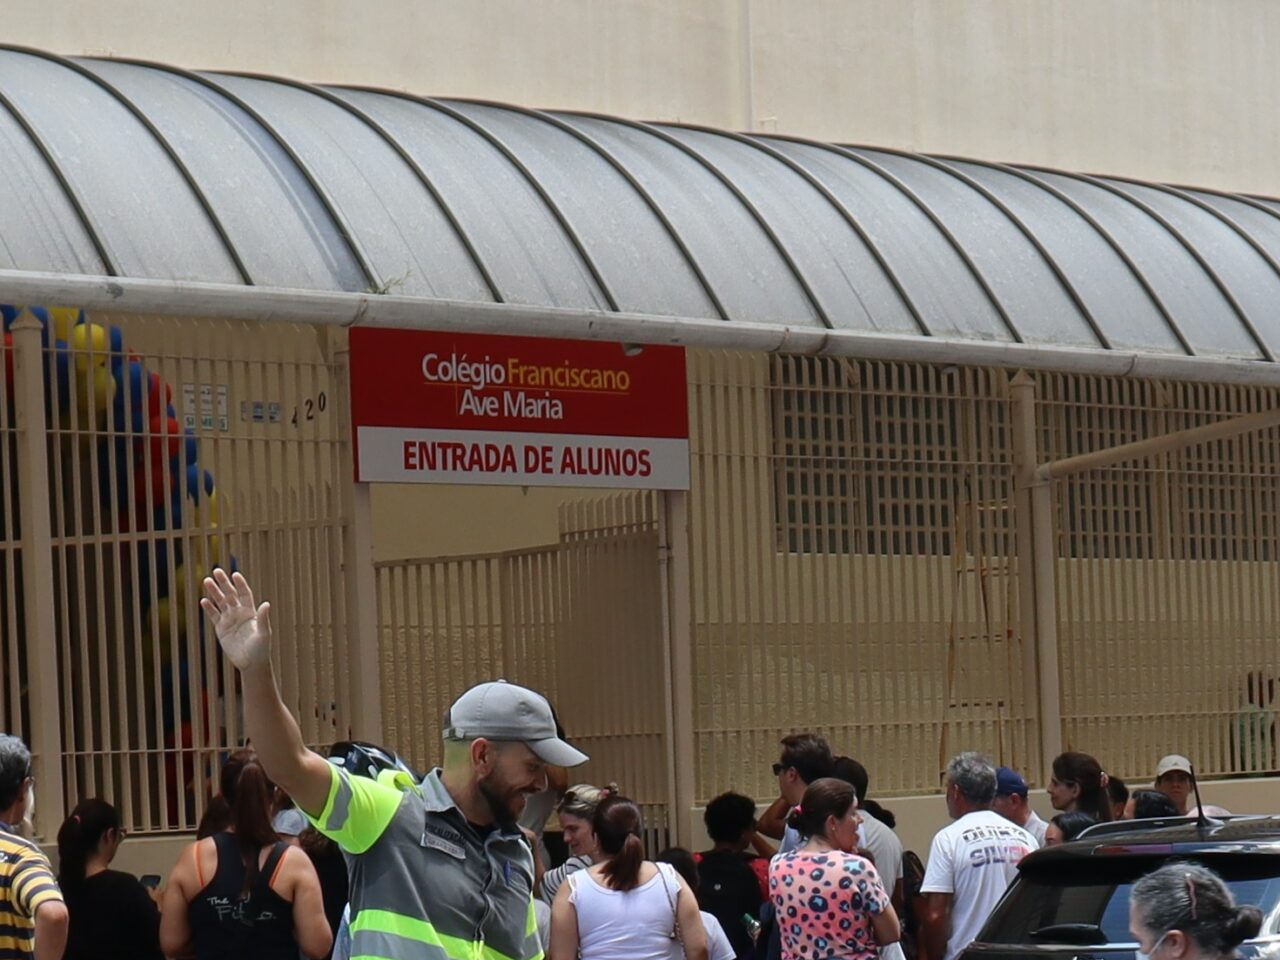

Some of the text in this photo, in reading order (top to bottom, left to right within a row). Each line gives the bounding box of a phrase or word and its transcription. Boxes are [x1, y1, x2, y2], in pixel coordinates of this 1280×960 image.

[421, 353, 631, 391] Colégio Franciscano
[459, 389, 563, 419] Ave Maria
[403, 440, 652, 477] ENTRADA DE ALUNOS
[206, 896, 229, 905] The
